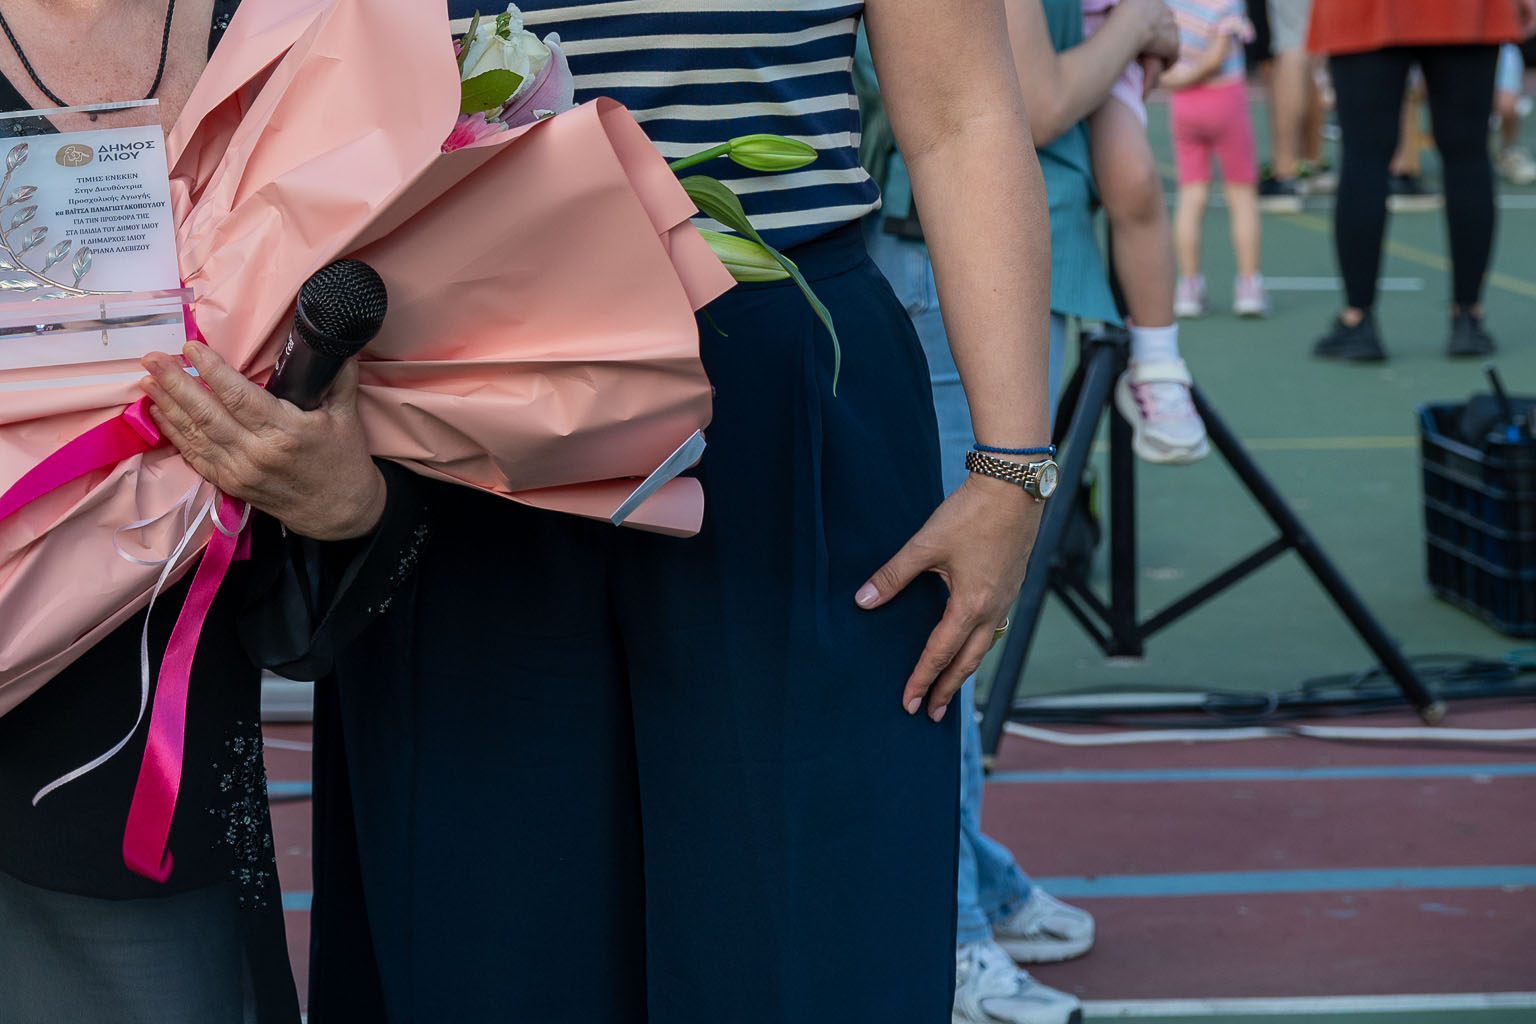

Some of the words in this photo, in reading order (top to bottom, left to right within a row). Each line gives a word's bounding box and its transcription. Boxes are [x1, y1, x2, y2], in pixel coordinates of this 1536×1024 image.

[98, 141, 155, 153] ΔΗΜΟΣ
[99, 151, 140, 162] ΙΛΙΟΥ
[76, 175, 104, 183] ΤΙΜΗΣ
[105, 173, 138, 181] ΕΝΕΚΕΝ
[95, 183, 143, 193] Διευθύντρια
[68, 194, 119, 205] Προσχολικής
[120, 192, 151, 201] Αγωγής
[90, 201, 166, 213] ΠΑΝΑΓΙΩΤΑΚΟΠΟΥΛΟΥ
[100, 214, 136, 222] ΠΡΟΣΦΟΡΑ
[79, 227, 102, 235] ΠΑΙΔΙΑ
[116, 224, 140, 232] ΔΗΜΟΥ
[141, 222, 159, 230] ΙΛΙΟΥ
[87, 236, 126, 245] ΔΗΜΑΡΧΟΣ
[115, 244, 150, 253] ΑΛΕΒΙΖΟΥ
